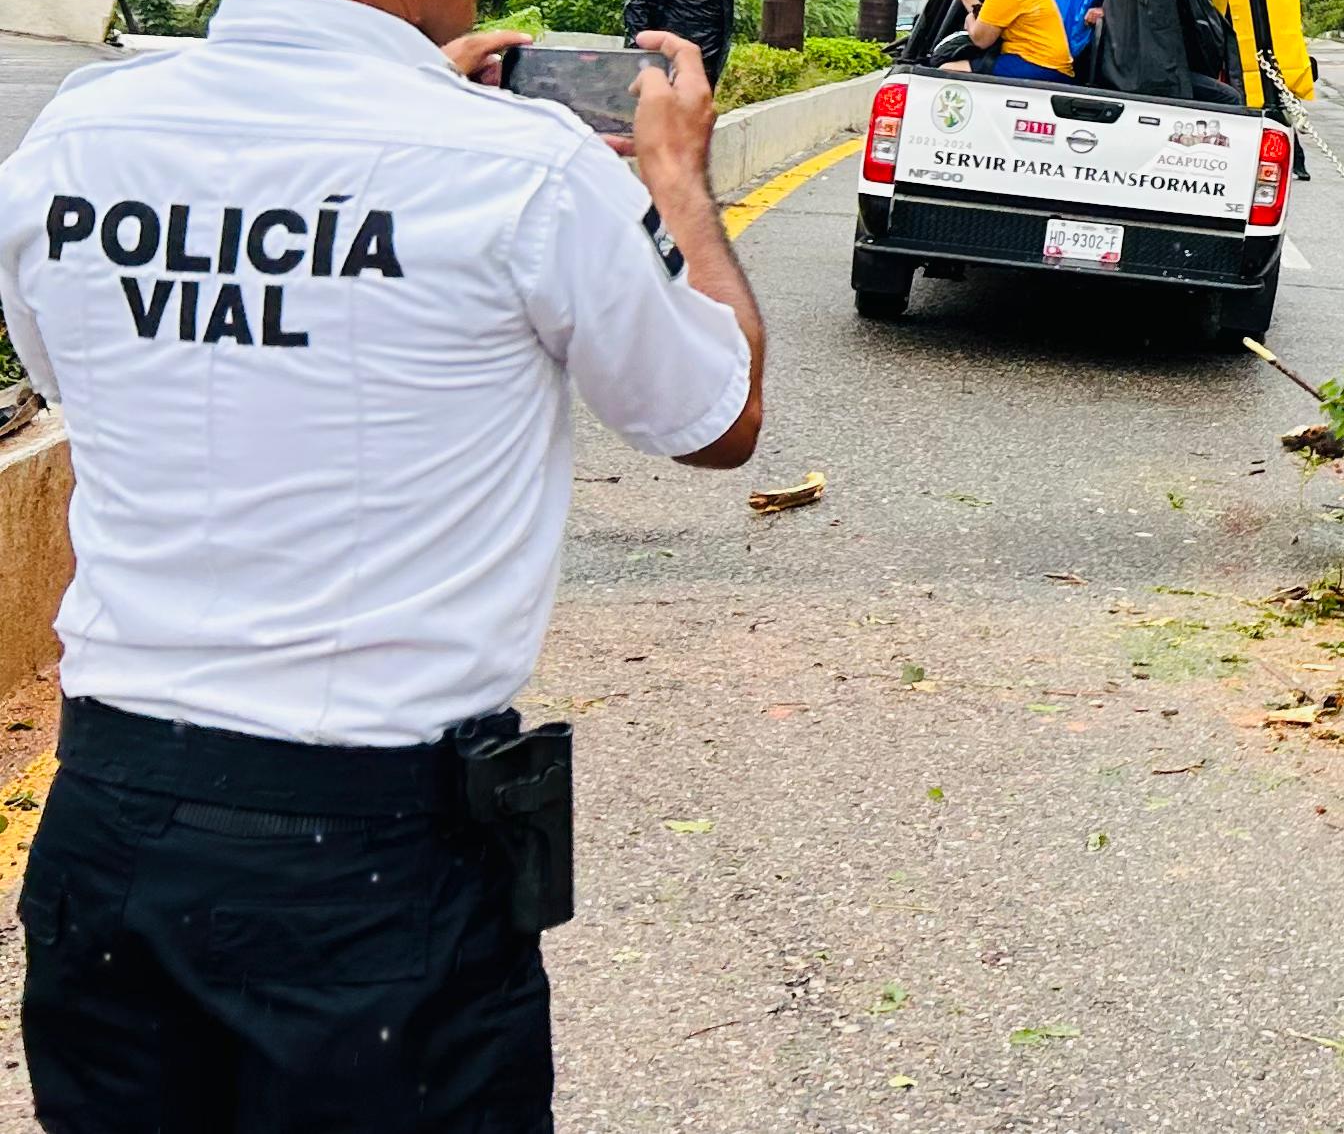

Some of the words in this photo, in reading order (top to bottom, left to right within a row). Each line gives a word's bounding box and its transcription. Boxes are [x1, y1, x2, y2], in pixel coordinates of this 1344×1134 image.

[1017, 120, 1054, 135] 911
[909, 135, 972, 150] 2021-2024
[1157, 154, 1228, 171] ACAPULCO
[908, 168, 964, 183] NP300
[934, 151, 1006, 171] SERVIR
[1013, 159, 1065, 178] PARA
[1074, 166, 1226, 197] TRANSFORMAR
[1225, 202, 1245, 213] SE
[46, 194, 404, 278] POLICÍA
[1050, 229, 1118, 251] HD-9302-F
[120, 276, 309, 347] VIAL
